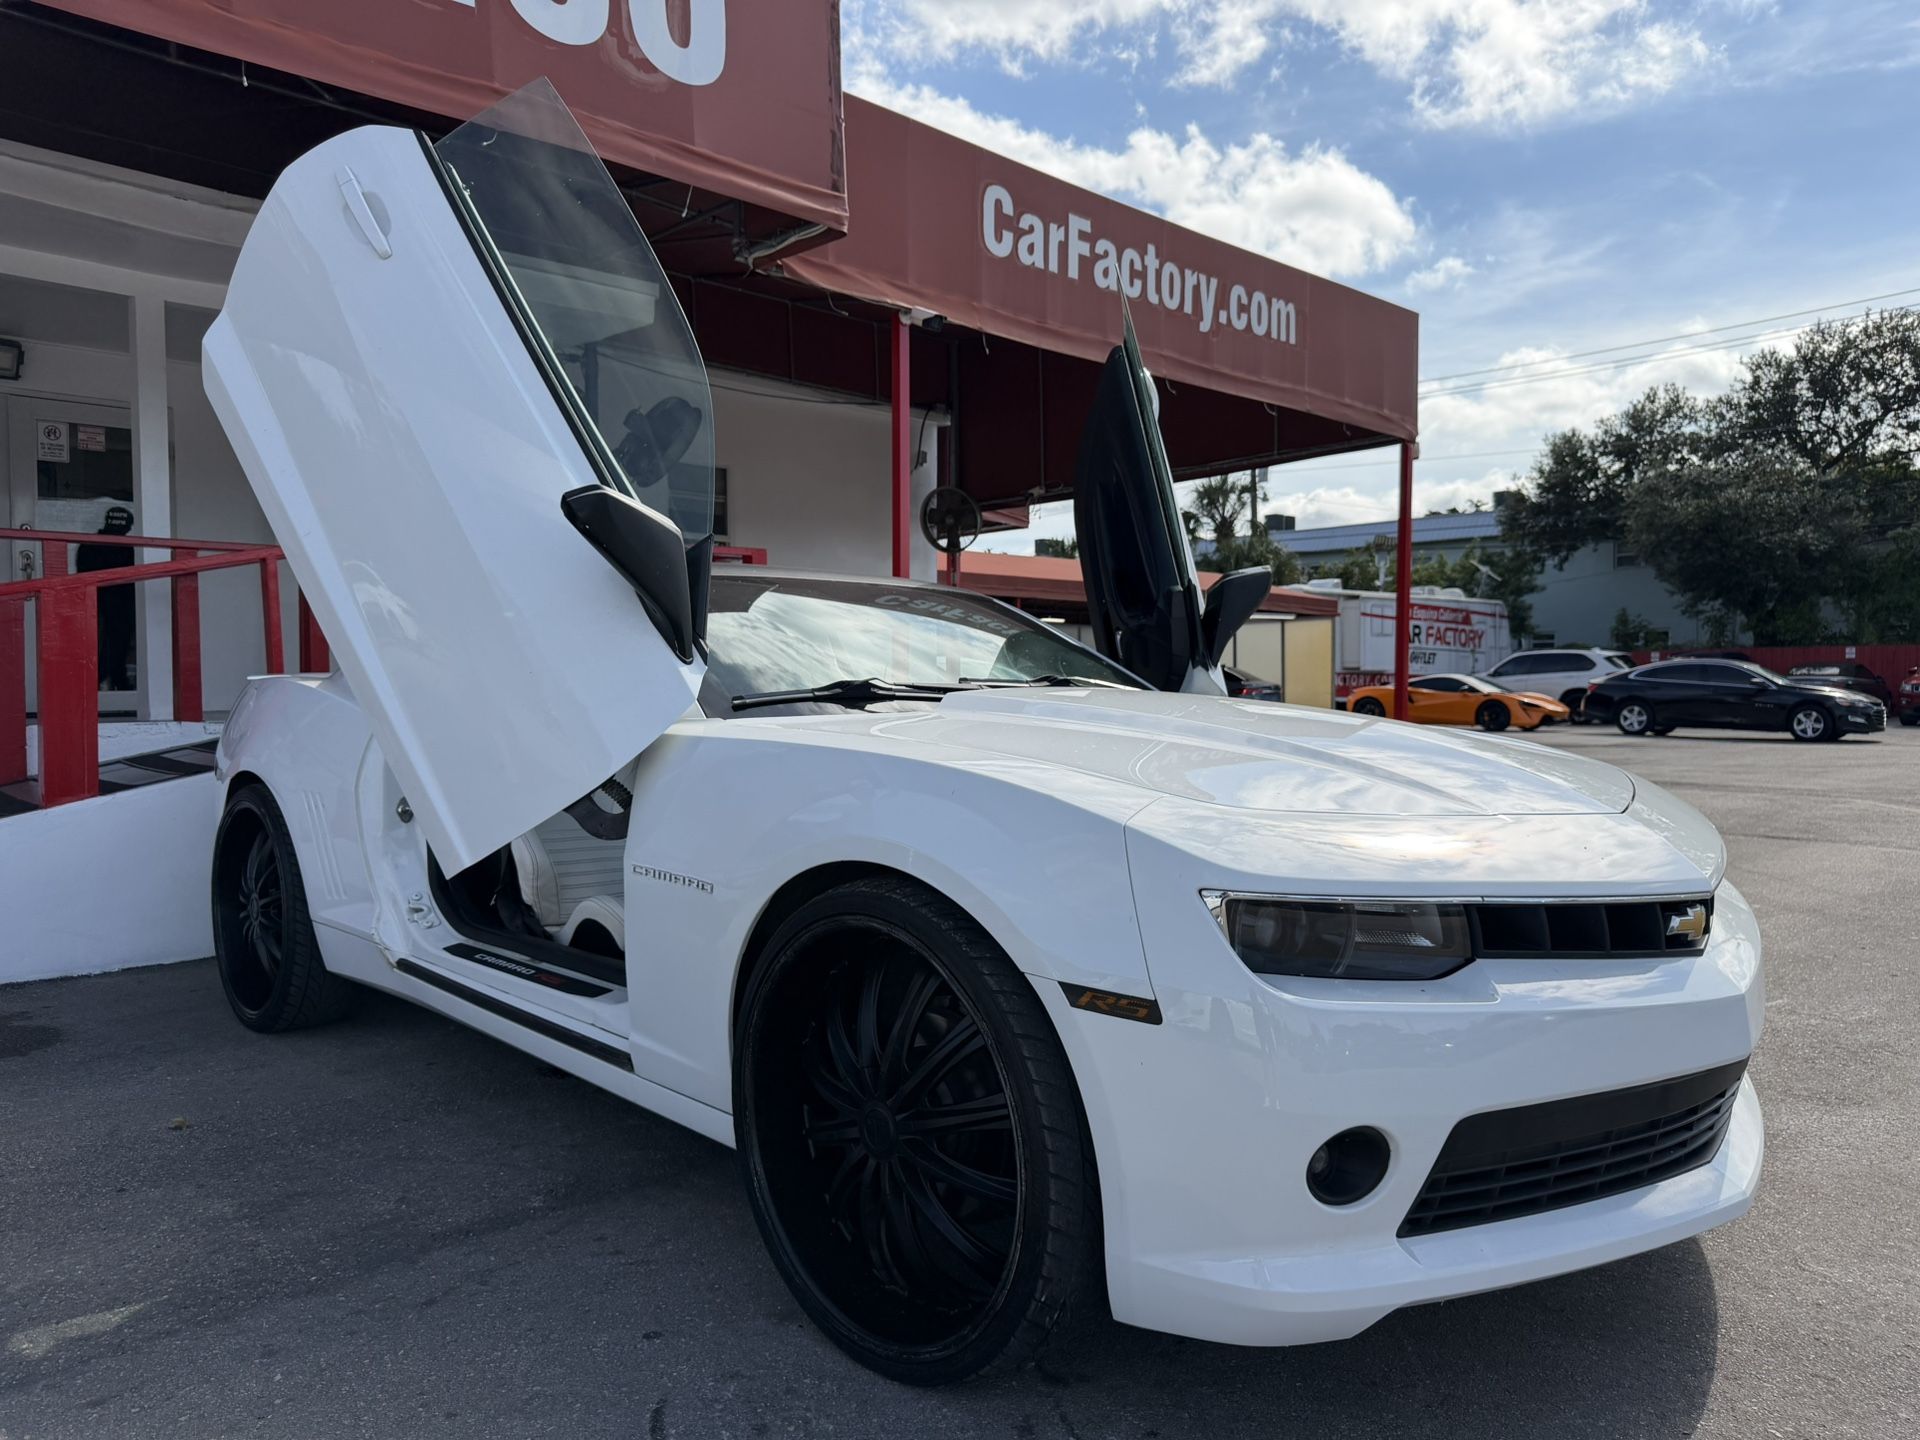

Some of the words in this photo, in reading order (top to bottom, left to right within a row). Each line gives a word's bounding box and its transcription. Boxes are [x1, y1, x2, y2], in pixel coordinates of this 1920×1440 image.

[983, 184, 1297, 345] CarFactory.com
[1425, 625, 1485, 648] FACTORY
[632, 863, 714, 895] CAMARO
[474, 952, 536, 976] CAMARO
[1076, 990, 1152, 1019] RS
